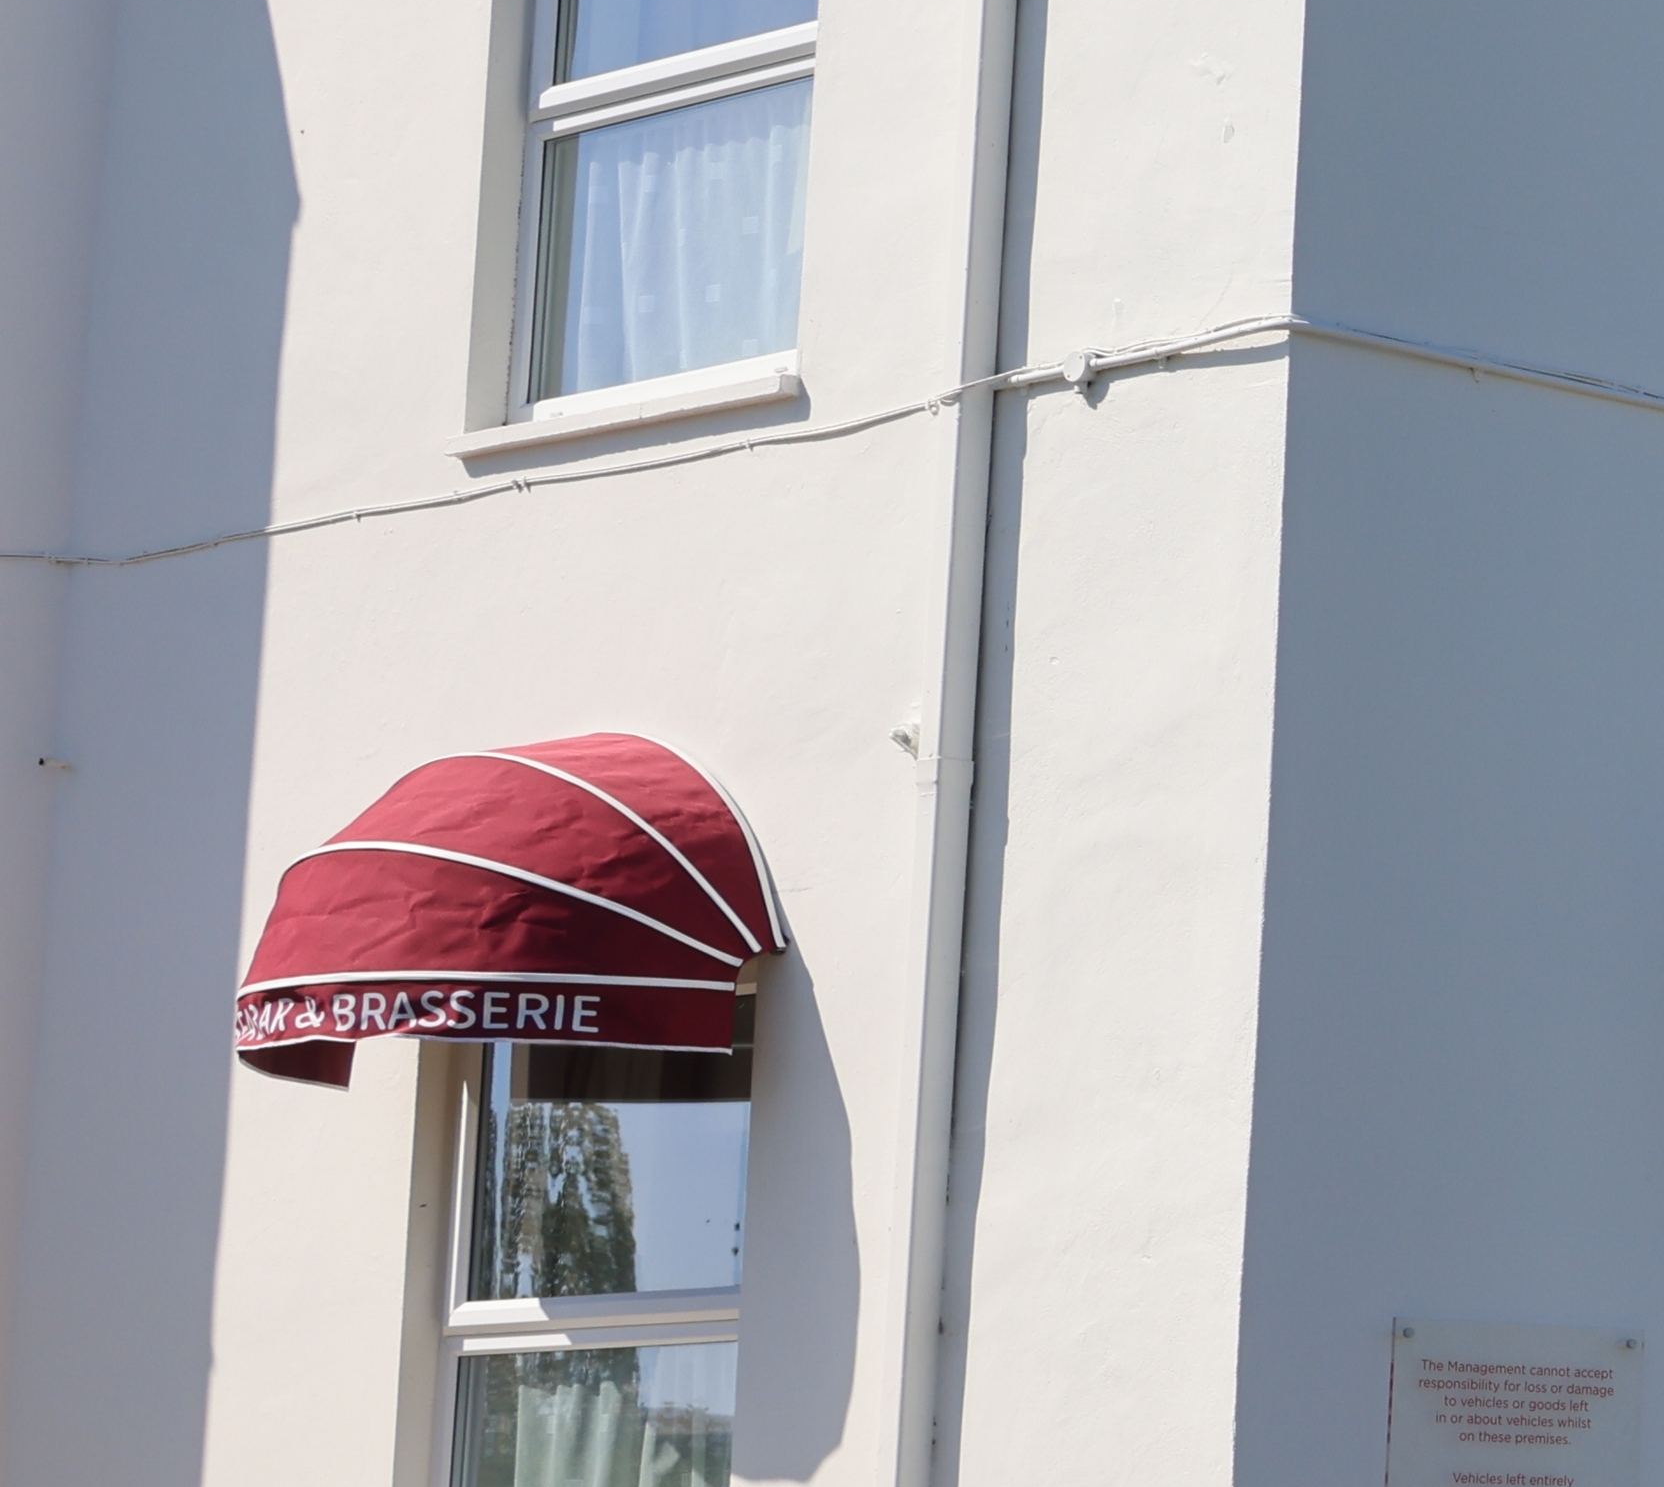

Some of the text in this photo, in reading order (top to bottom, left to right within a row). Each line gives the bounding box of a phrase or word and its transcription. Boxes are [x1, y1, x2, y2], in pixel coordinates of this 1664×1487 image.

[295, 995, 326, 1030] &
[331, 989, 602, 1034] BRASSERIE
[1422, 1359, 1613, 1380] The Management cannot accept
[1418, 1378, 1614, 1397] responsibility for loss or damage
[1444, 1396, 1589, 1412] to vehicles or goods left
[1436, 1413, 1591, 1429] in or about vehicles whilst
[1459, 1431, 1570, 1446] on these premises.
[1453, 1472, 1574, 1487] Vehicles left entirely
